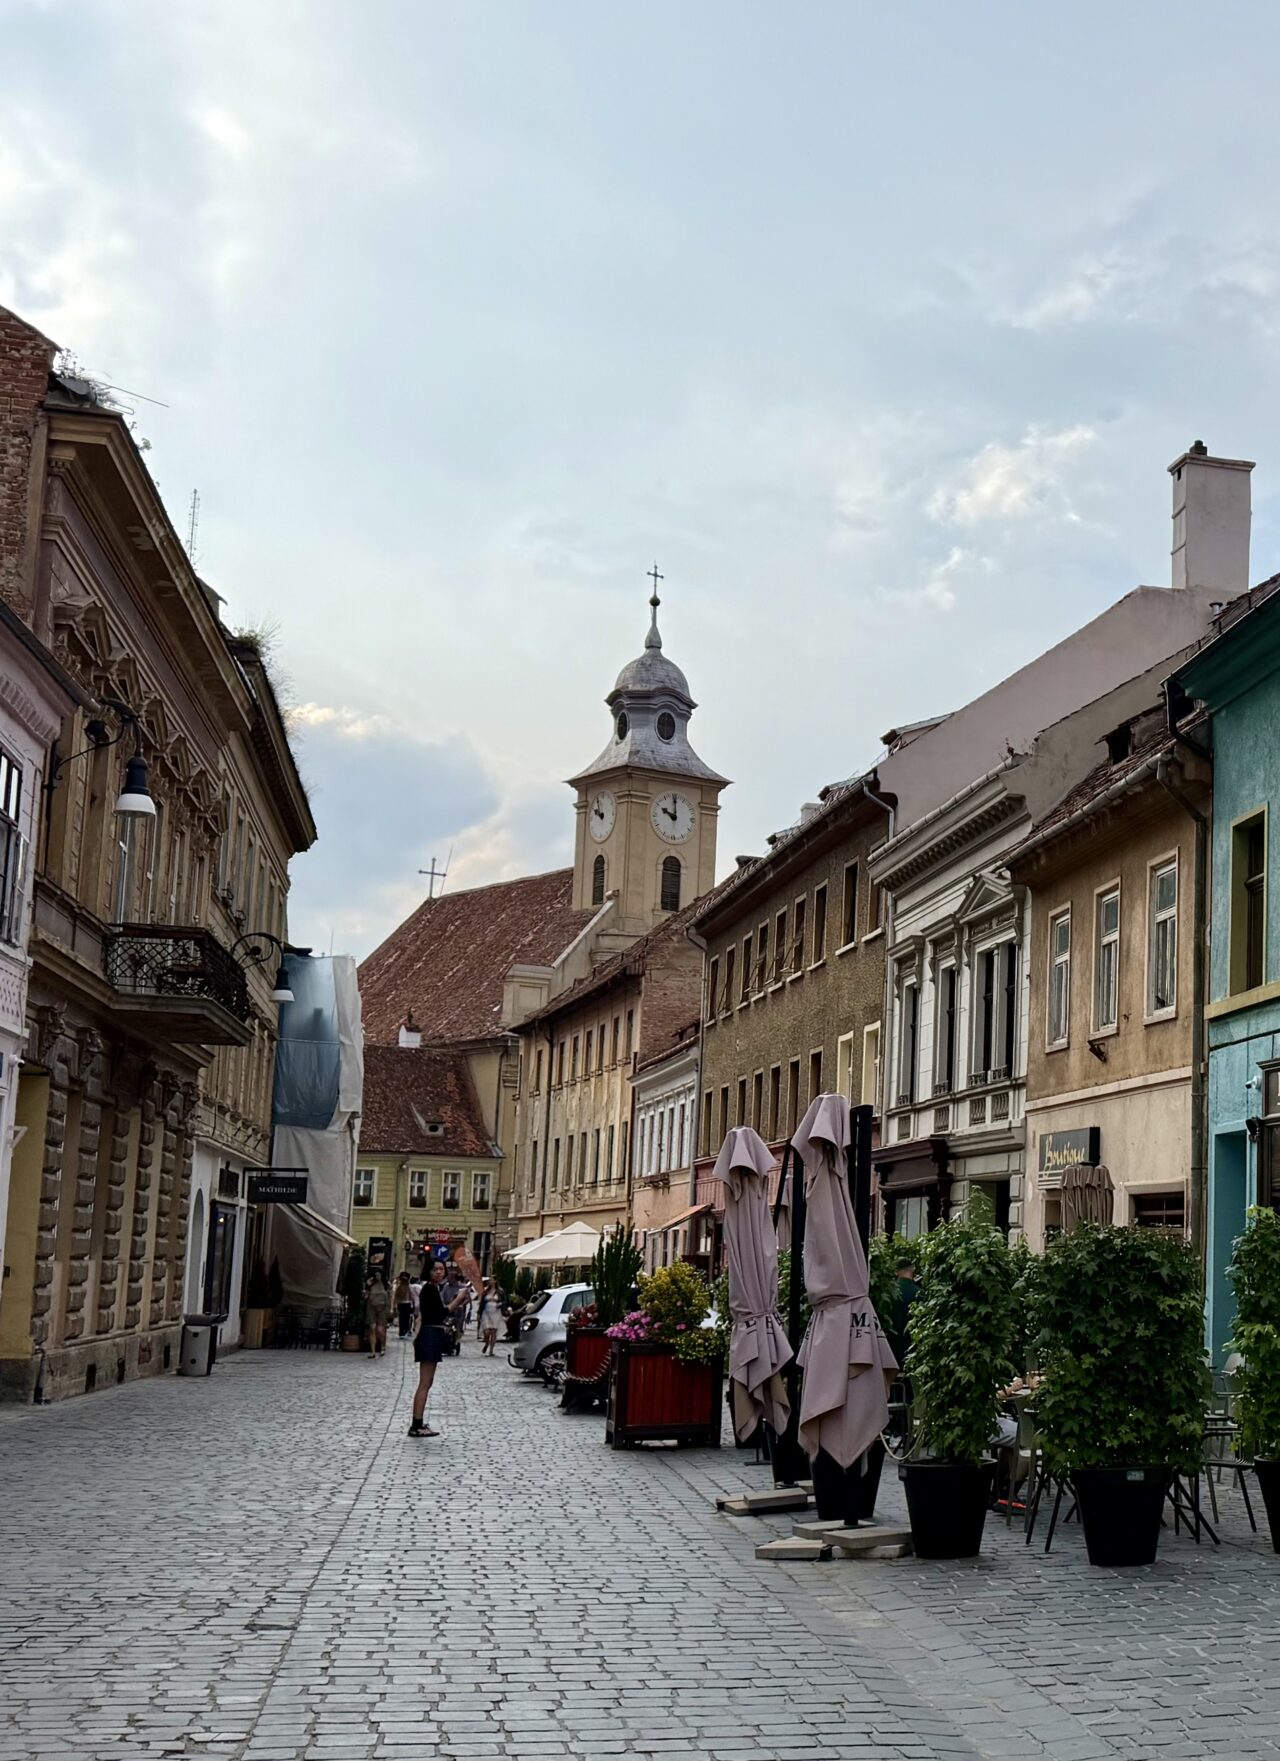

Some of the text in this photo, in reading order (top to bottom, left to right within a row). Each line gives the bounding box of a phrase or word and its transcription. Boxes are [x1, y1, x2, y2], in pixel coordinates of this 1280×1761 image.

[1043, 1134, 1085, 1179] Boutique
[258, 1185, 298, 1193] MATHILDE
[435, 1233, 449, 1241] STOP
